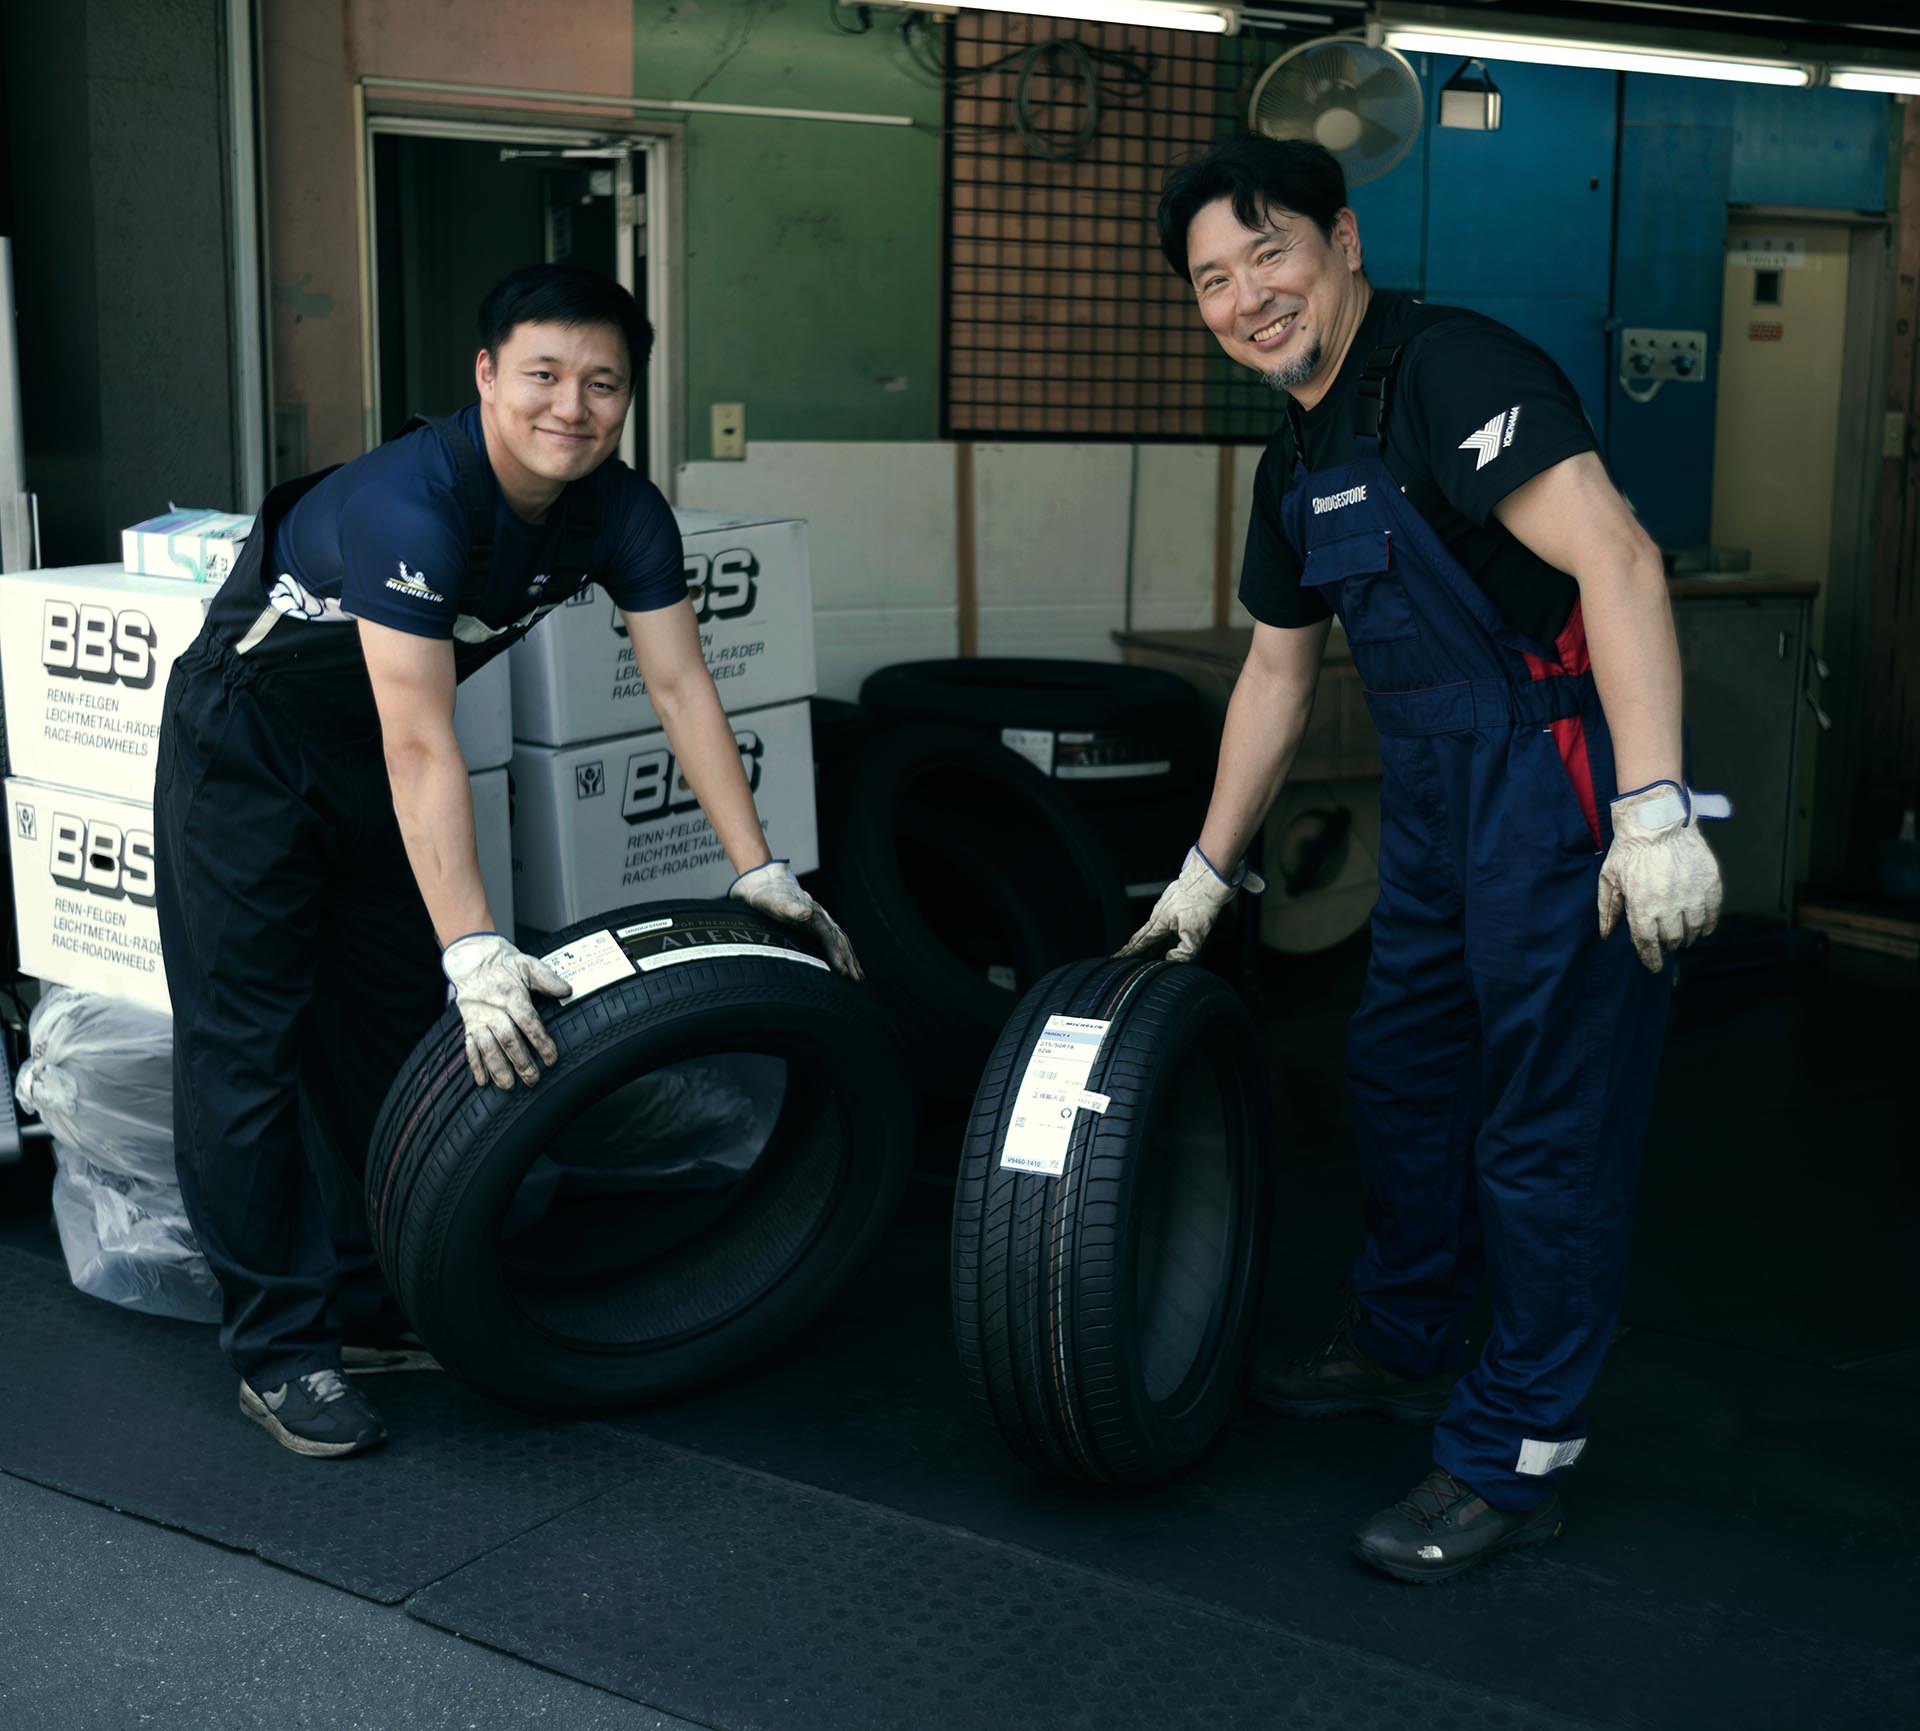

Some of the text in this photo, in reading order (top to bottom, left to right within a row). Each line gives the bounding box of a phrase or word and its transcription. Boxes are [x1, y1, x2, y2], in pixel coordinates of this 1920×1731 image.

[1502, 406, 1520, 448] YOKOHAMA
[1312, 485, 1367, 514] BRIDGESTONE
[385, 580, 445, 602] MICHELIN
[41, 599, 157, 690] BBS
[47, 688, 120, 712] RENN-FELGEN
[44, 725, 148, 757] RACE-ROADWHEELS
[627, 817, 712, 849] RENN-FELGE
[49, 811, 156, 909] BBS
[54, 897, 127, 927] RENN-FELGEN
[53, 916, 163, 956] LEICHTMETALL-RÄDE
[661, 929, 800, 950] ALENZA
[52, 933, 156, 973] RACE-ROADWHEELS
[1064, 1021, 1104, 1030] MICHELIN
